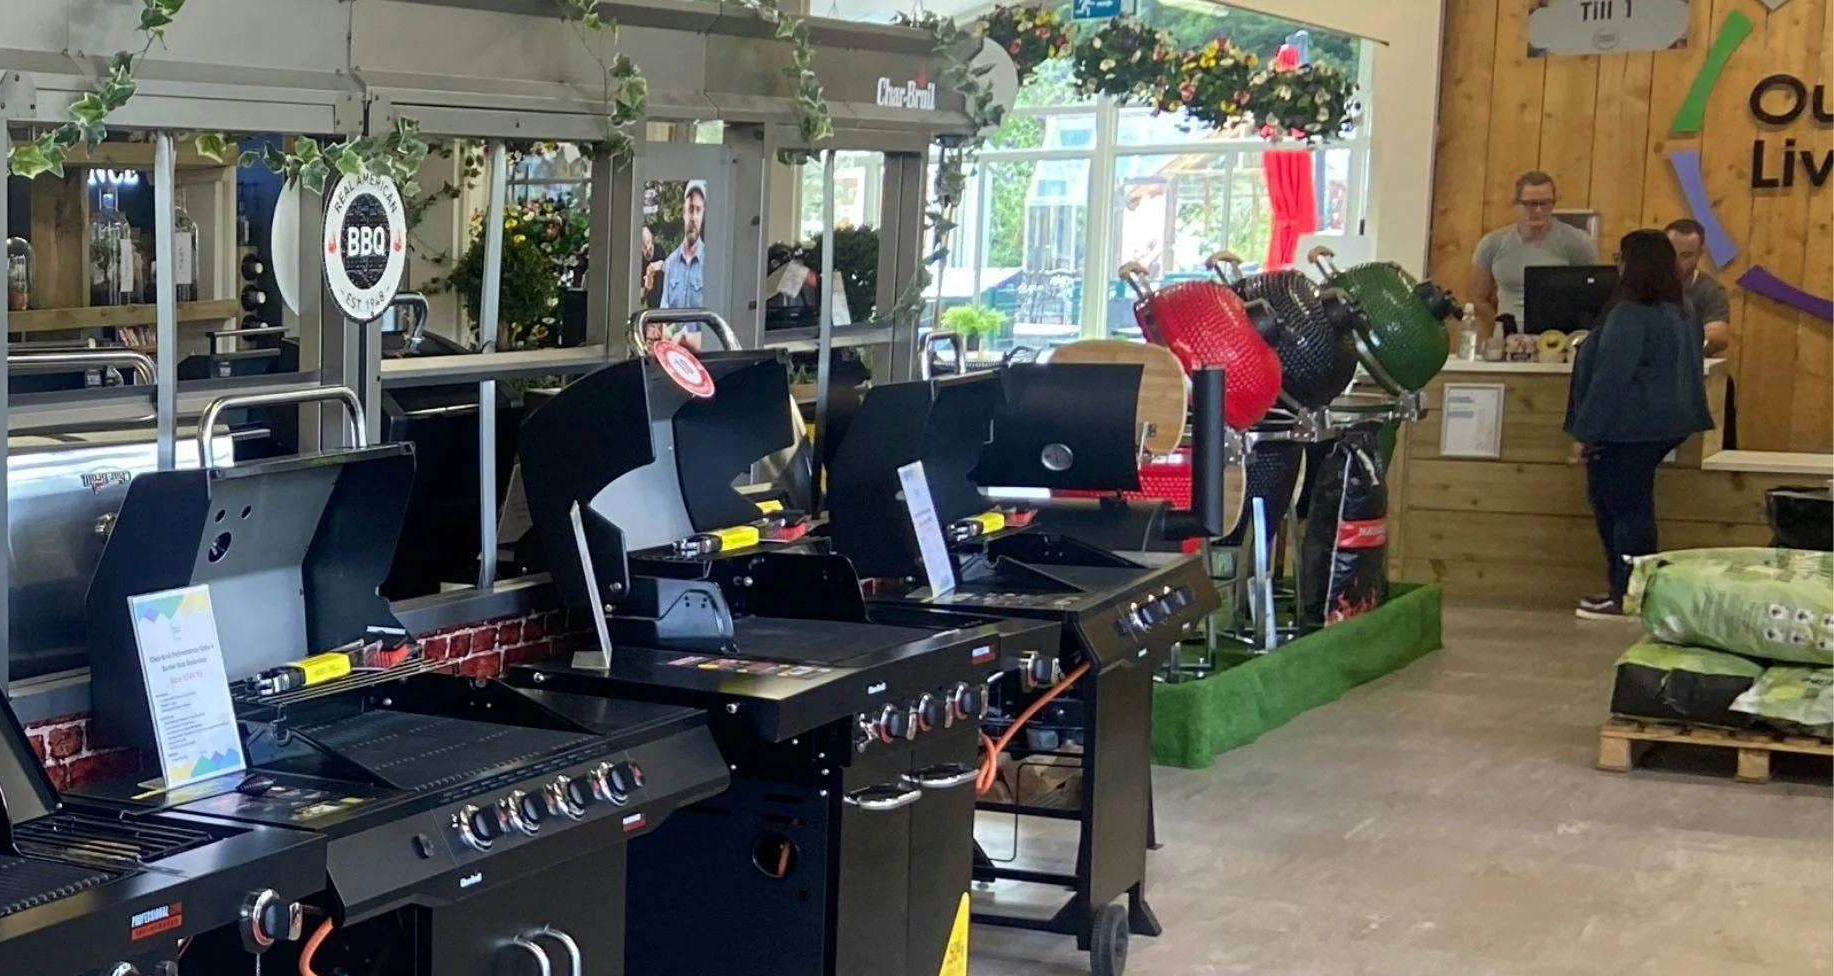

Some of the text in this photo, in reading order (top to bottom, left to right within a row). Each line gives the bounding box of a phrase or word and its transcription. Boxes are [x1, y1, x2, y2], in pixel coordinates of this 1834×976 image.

[1580, 0, 1633, 21] Till 1
[876, 76, 936, 111] Char-Broil
[334, 180, 355, 213] REAL
[347, 226, 385, 257] BBQ
[345, 292, 362, 309] EST
